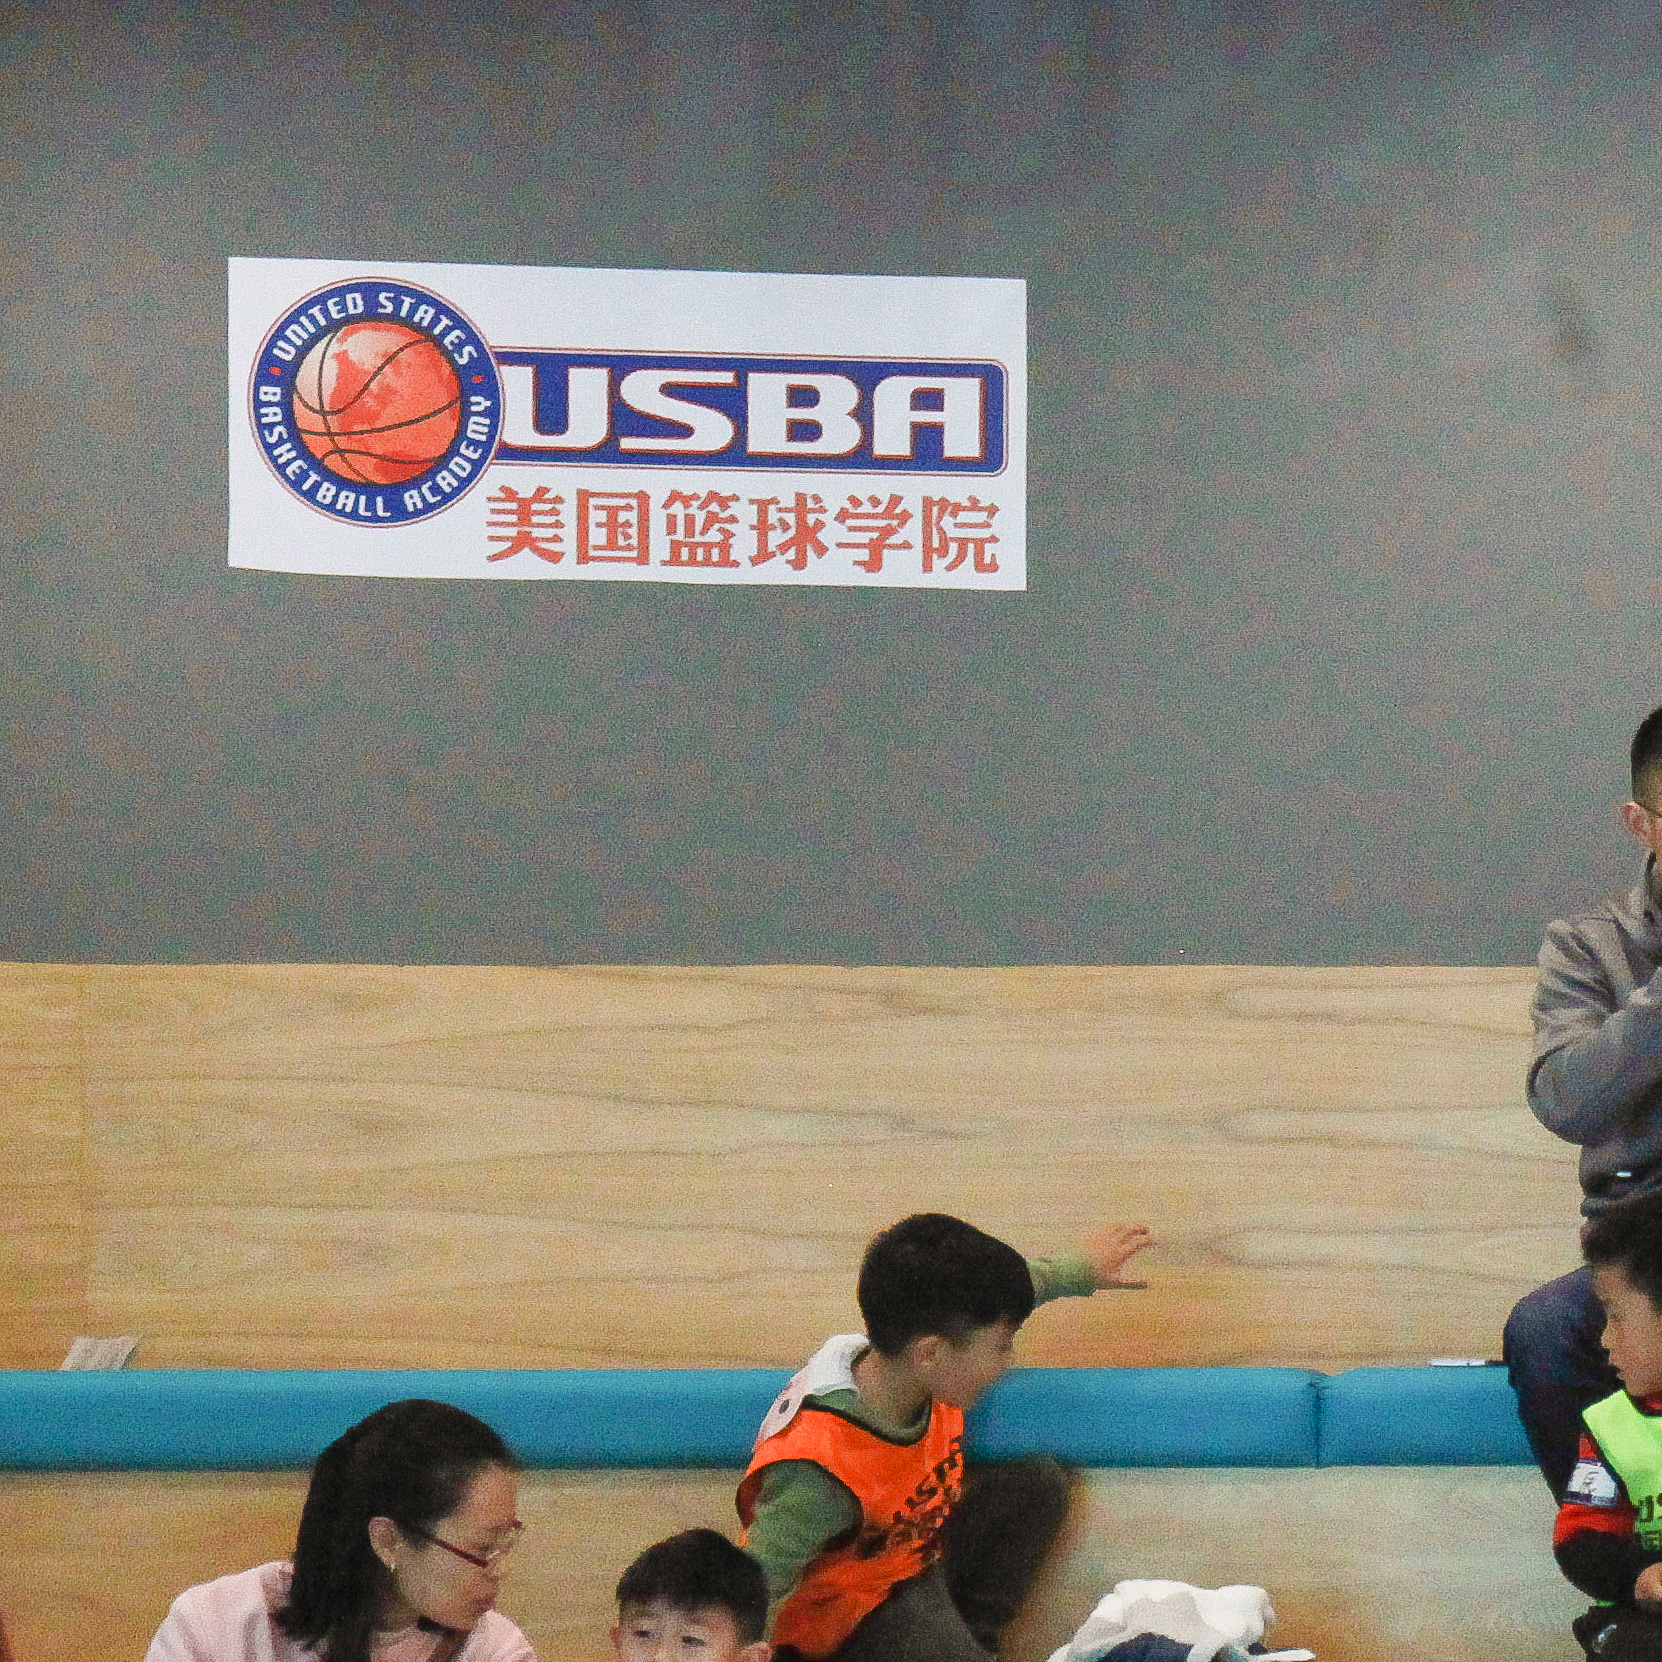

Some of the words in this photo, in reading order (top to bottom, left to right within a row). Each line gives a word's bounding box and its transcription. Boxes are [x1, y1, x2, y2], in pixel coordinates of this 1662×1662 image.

[274, 291, 366, 363] UNITED
[375, 290, 478, 366] STATES
[257, 385, 394, 519] BASKETBALL
[403, 394, 493, 512] ACADEMY
[499, 361, 985, 462] USBA
[485, 484, 1001, 575] 美国篮球学院
